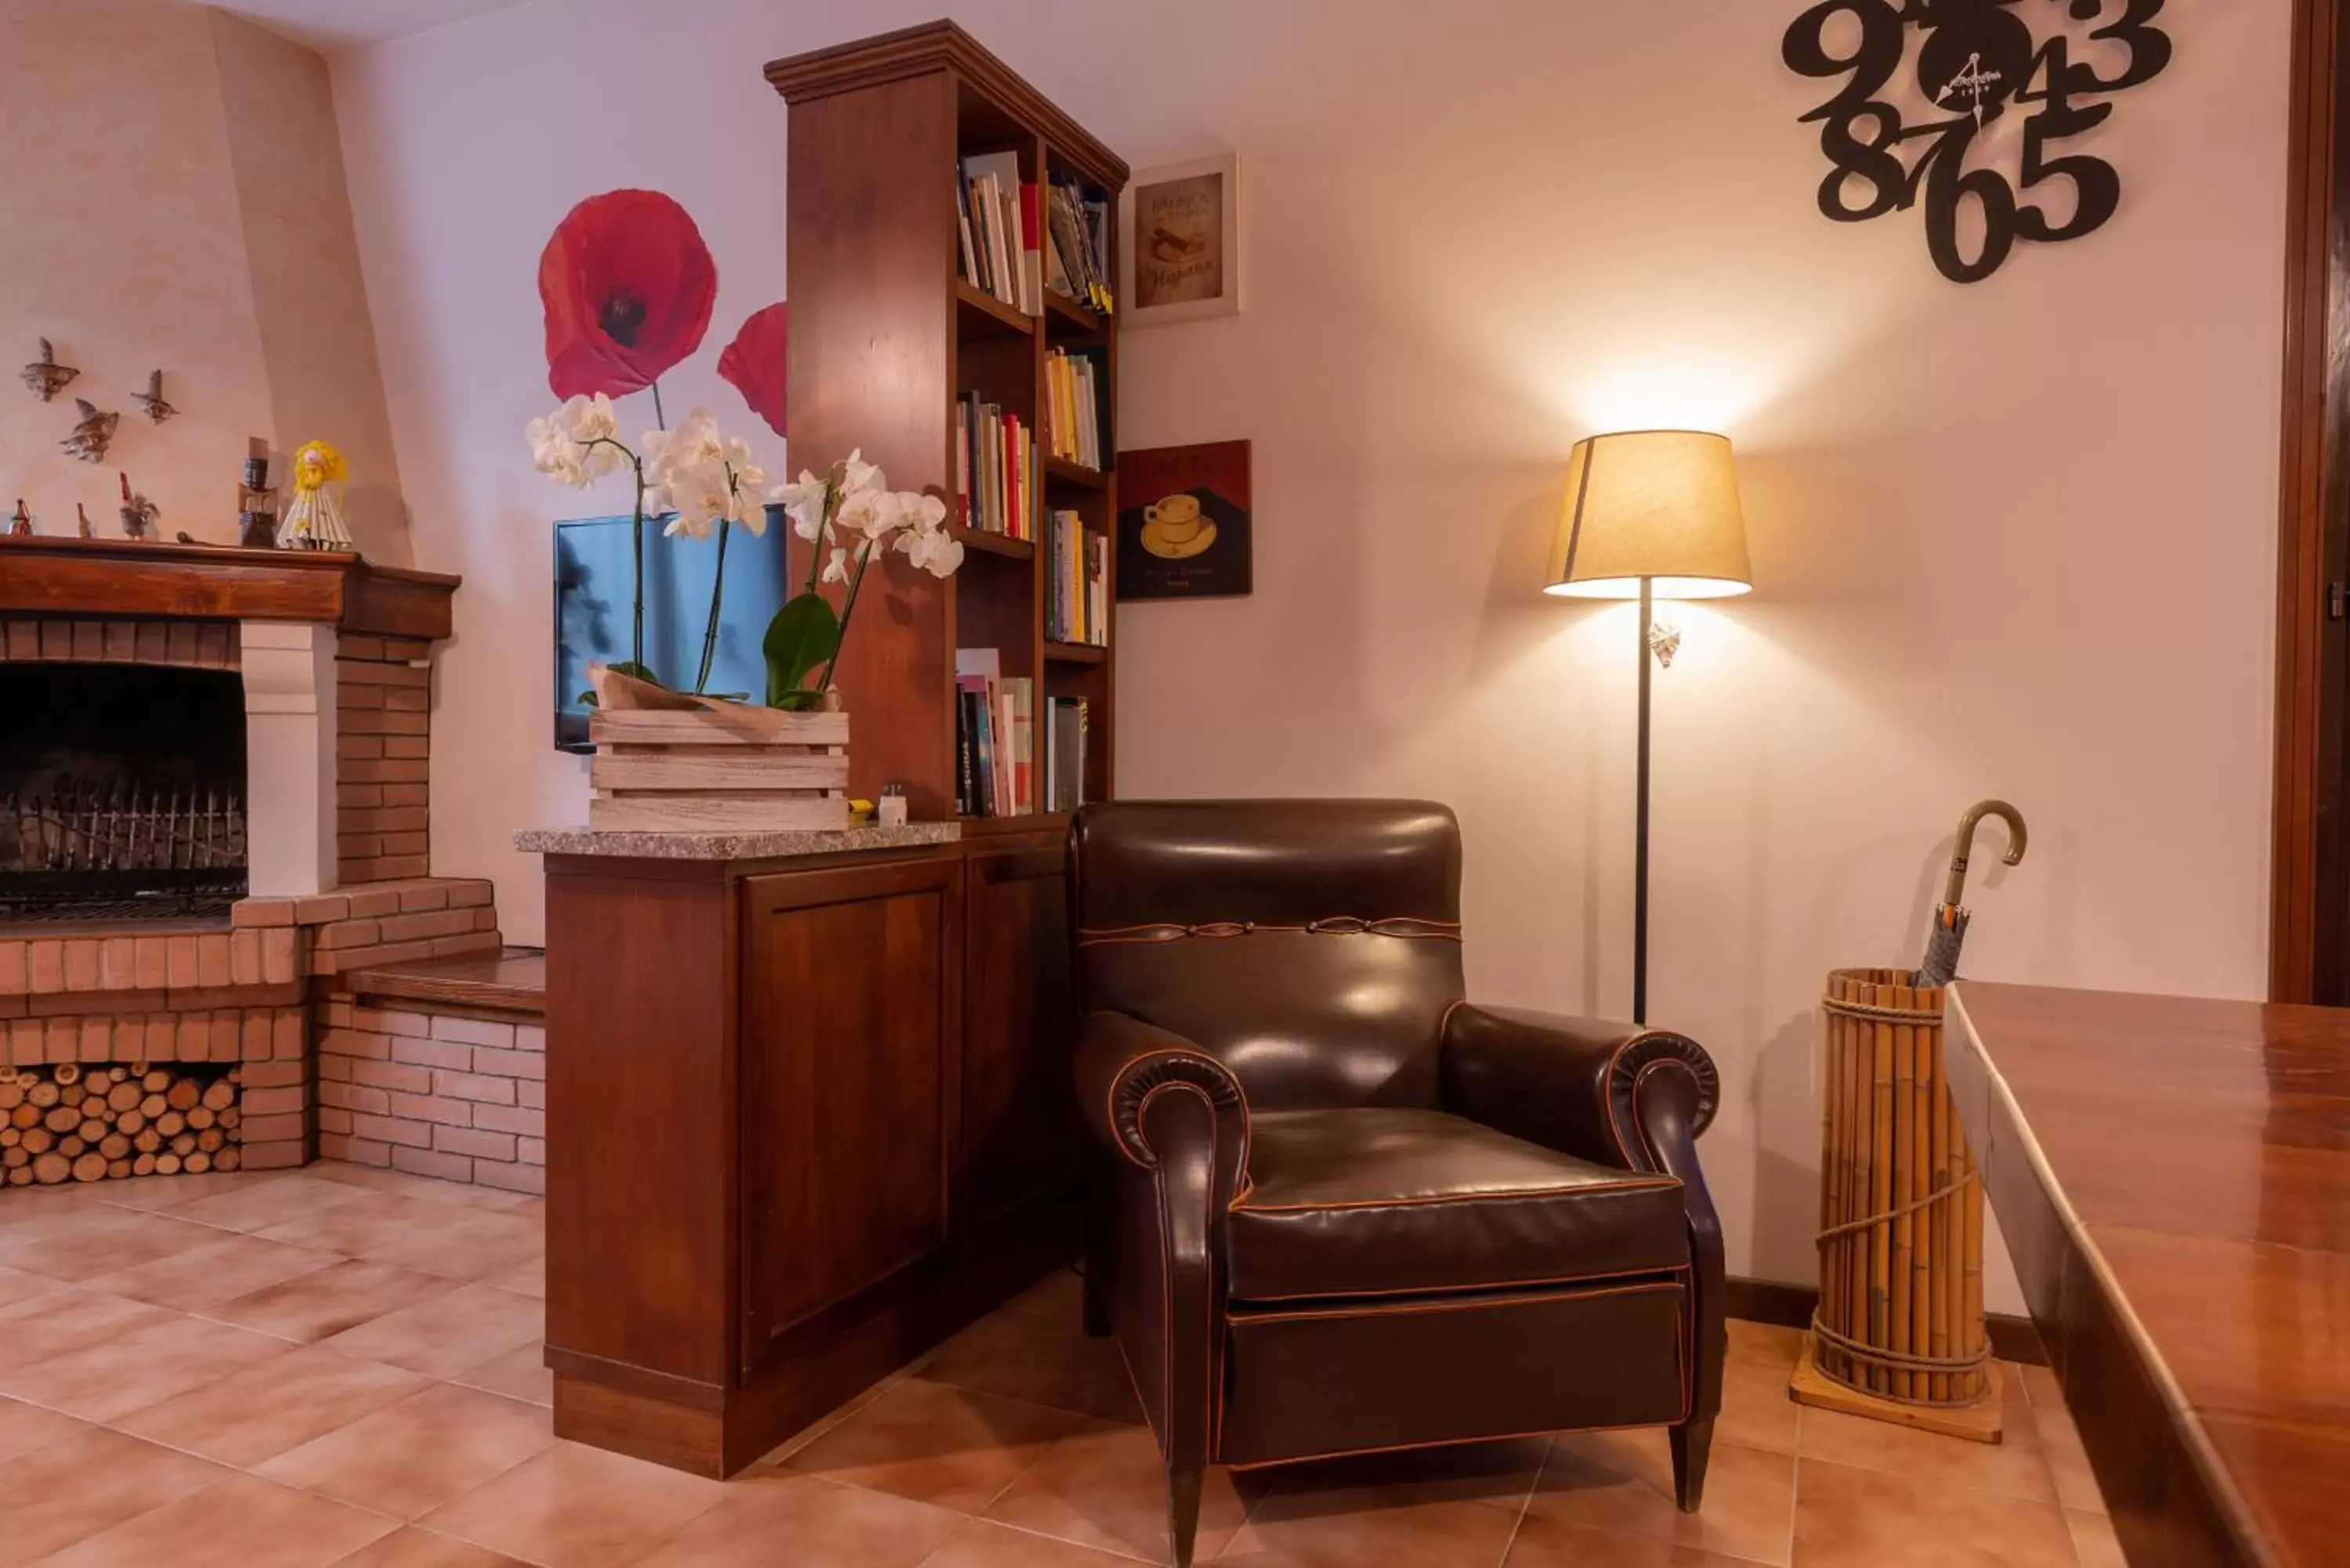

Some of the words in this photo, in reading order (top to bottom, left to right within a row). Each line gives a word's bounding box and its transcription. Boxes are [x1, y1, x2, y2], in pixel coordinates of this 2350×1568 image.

[1782, 0, 1904, 122] 9
[2015, 35, 2077, 117] 4
[2067, 0, 2172, 92] 3
[1817, 101, 1906, 222] 8
[1925, 114, 2016, 284] 6
[2016, 102, 2120, 242] 5
